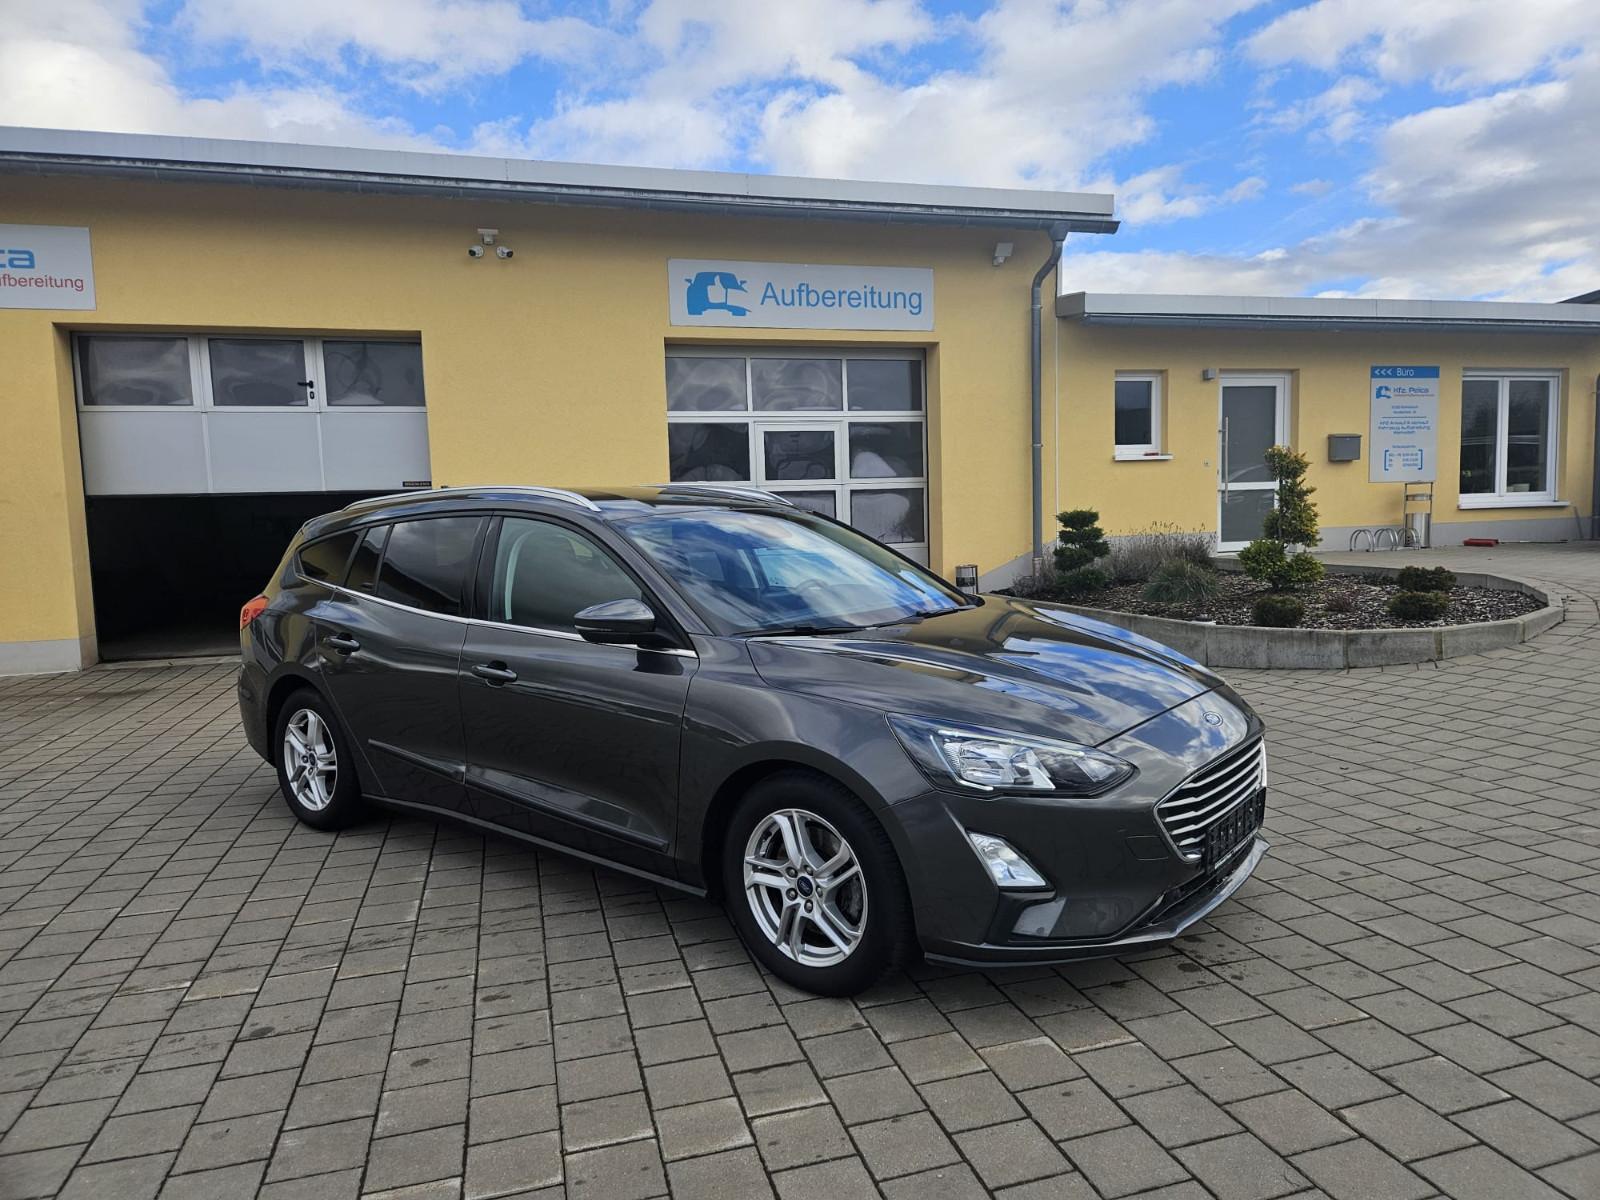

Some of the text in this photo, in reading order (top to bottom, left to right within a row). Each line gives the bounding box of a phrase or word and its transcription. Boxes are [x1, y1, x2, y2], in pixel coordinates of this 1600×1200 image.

[0, 249, 35, 269] a
[0, 273, 84, 292] fbereitung
[760, 281, 922, 315] Aufbereitung
